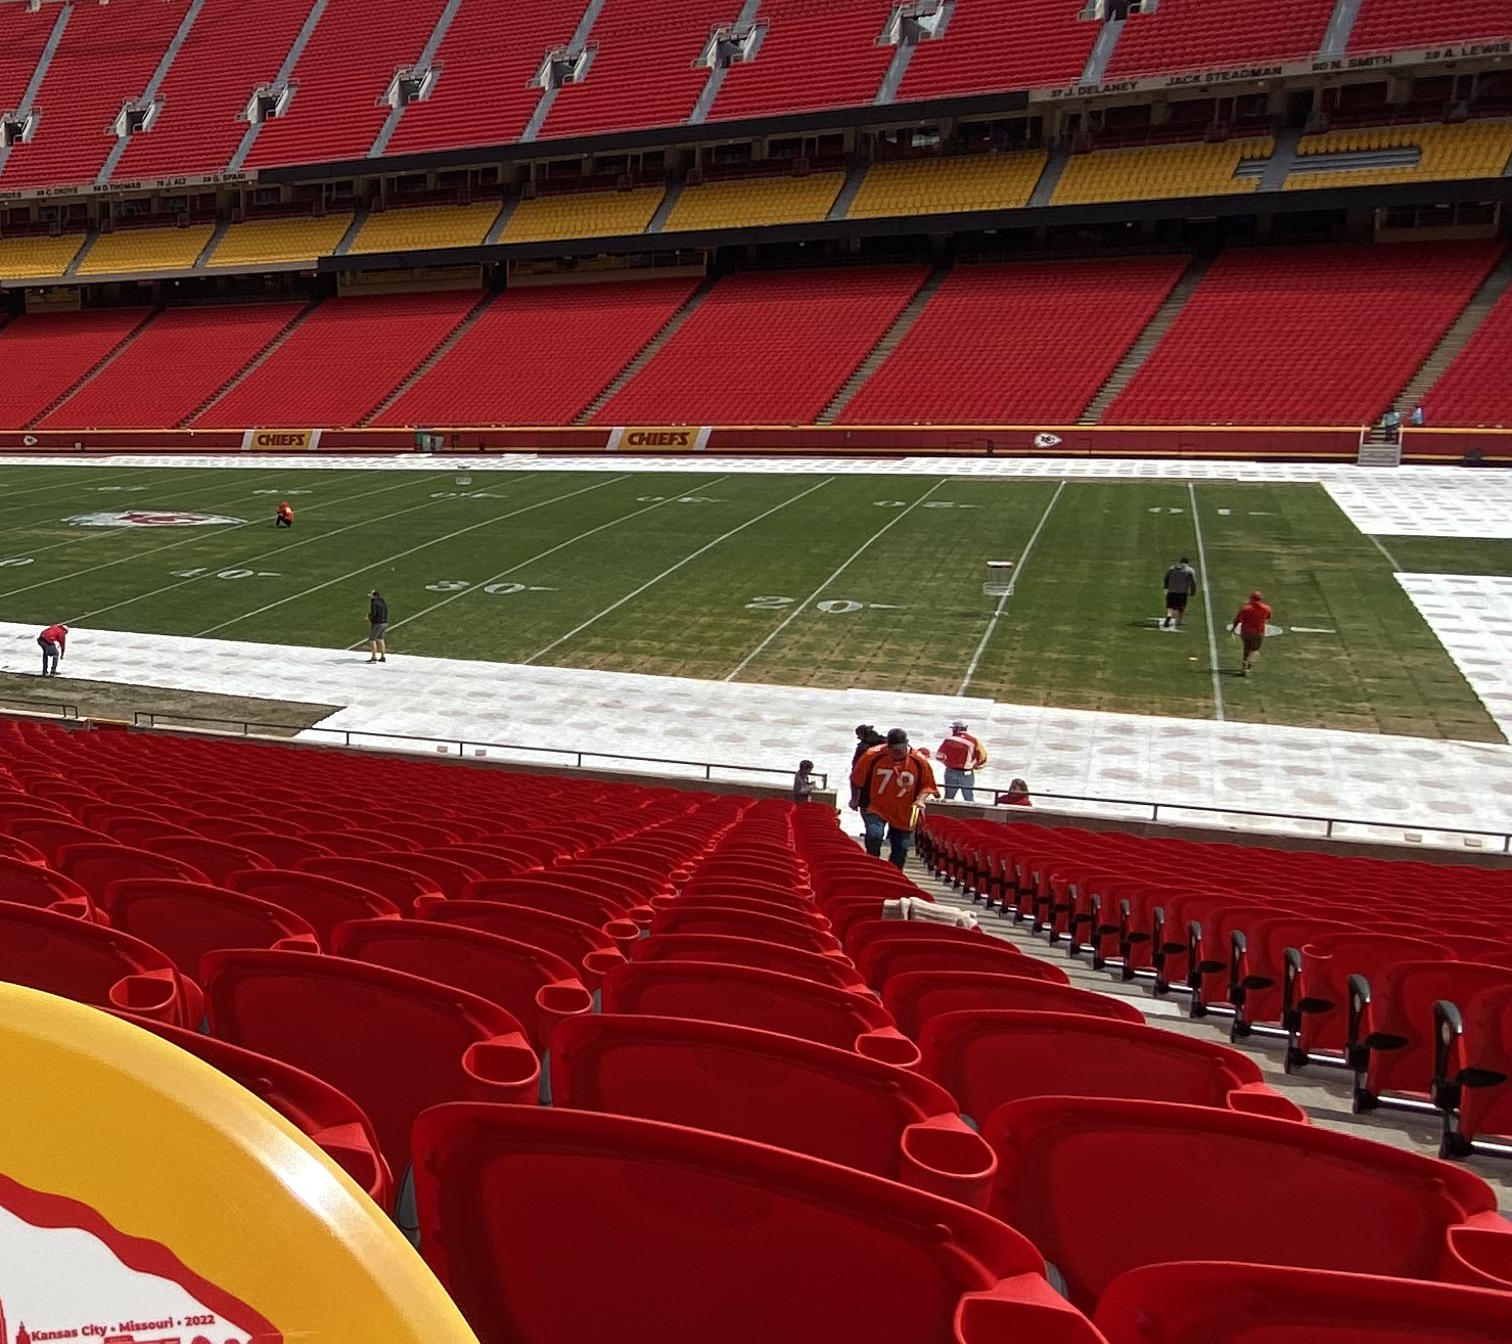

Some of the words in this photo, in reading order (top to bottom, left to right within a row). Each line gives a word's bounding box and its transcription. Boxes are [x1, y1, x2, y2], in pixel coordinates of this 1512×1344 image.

[1348, 55, 1393, 69] SMITH
[1165, 73, 1203, 87] JACK
[1206, 67, 1283, 83] STEADMAN
[1077, 80, 1138, 96] DELANEY
[258, 433, 305, 446] CHIEFS
[628, 432, 690, 446] CHIEFS
[876, 768, 915, 798] 79
[31, 1326, 78, 1341] Kansas
[82, 1323, 107, 1337] City
[119, 1317, 173, 1332] Missouri
[184, 1314, 215, 1327] 2022
